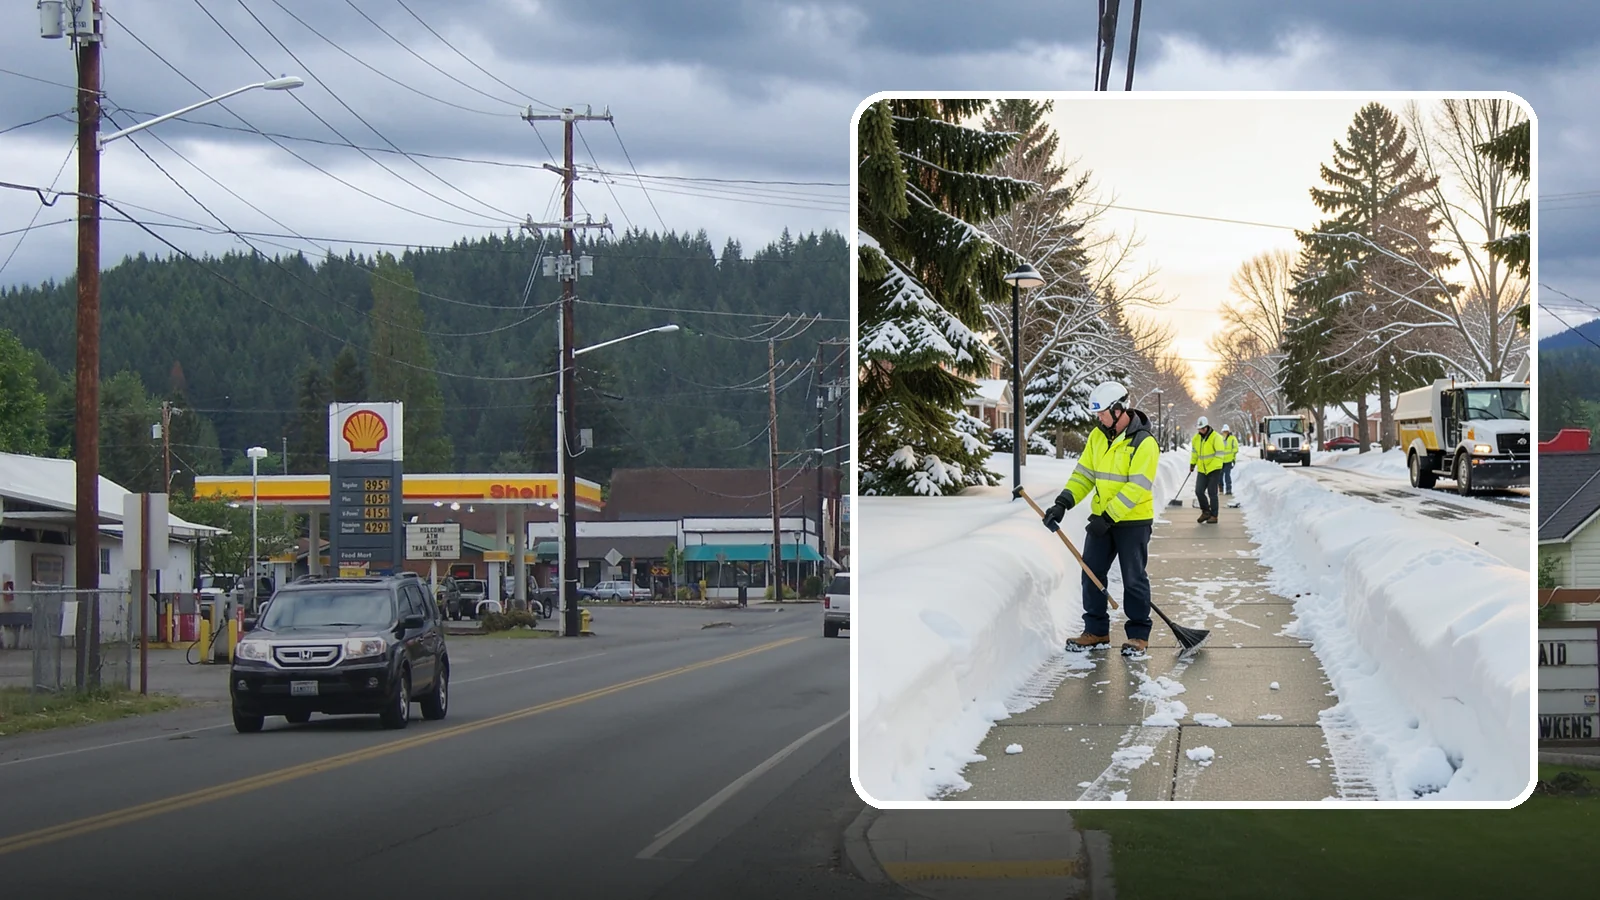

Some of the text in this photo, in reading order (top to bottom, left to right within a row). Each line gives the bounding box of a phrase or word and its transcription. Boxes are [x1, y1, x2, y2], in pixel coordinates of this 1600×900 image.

[366, 480, 383, 490] 395
[490, 484, 547, 499] Shell
[366, 494, 383, 504] 405
[366, 508, 383, 518] 415
[366, 522, 383, 533] 429
[1538, 642, 1566, 665] AID
